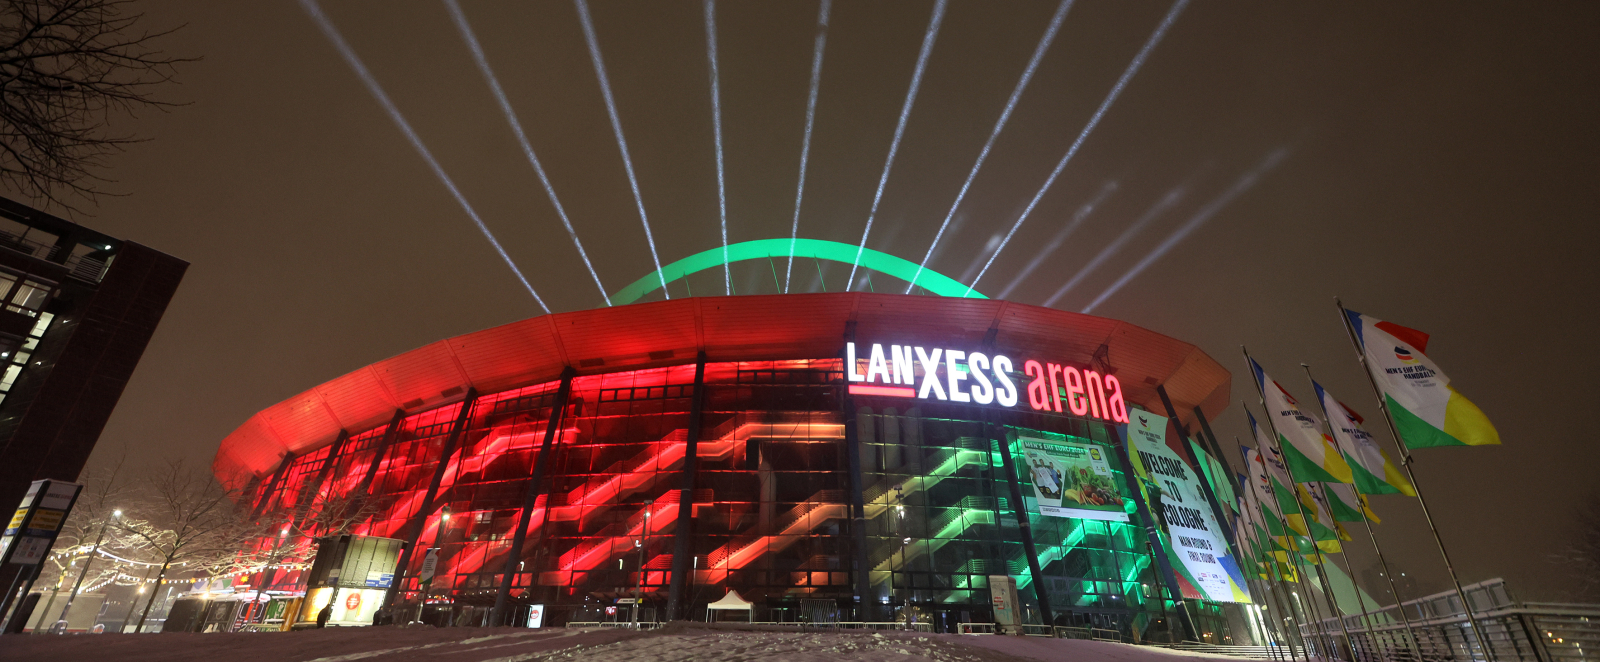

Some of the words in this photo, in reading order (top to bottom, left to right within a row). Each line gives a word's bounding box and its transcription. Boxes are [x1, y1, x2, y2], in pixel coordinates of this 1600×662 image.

[846, 342, 1018, 407] LANXESS
[1024, 359, 1130, 424] arena
[1137, 450, 1188, 481] WELCOME
[1164, 480, 1183, 503] TO
[1163, 504, 1208, 532] COLOGNE
[1178, 535, 1194, 548] MAIN
[1190, 537, 1208, 550] ROUND
[1188, 550, 1202, 562] FINAL
[1200, 552, 1216, 564] ROUND
